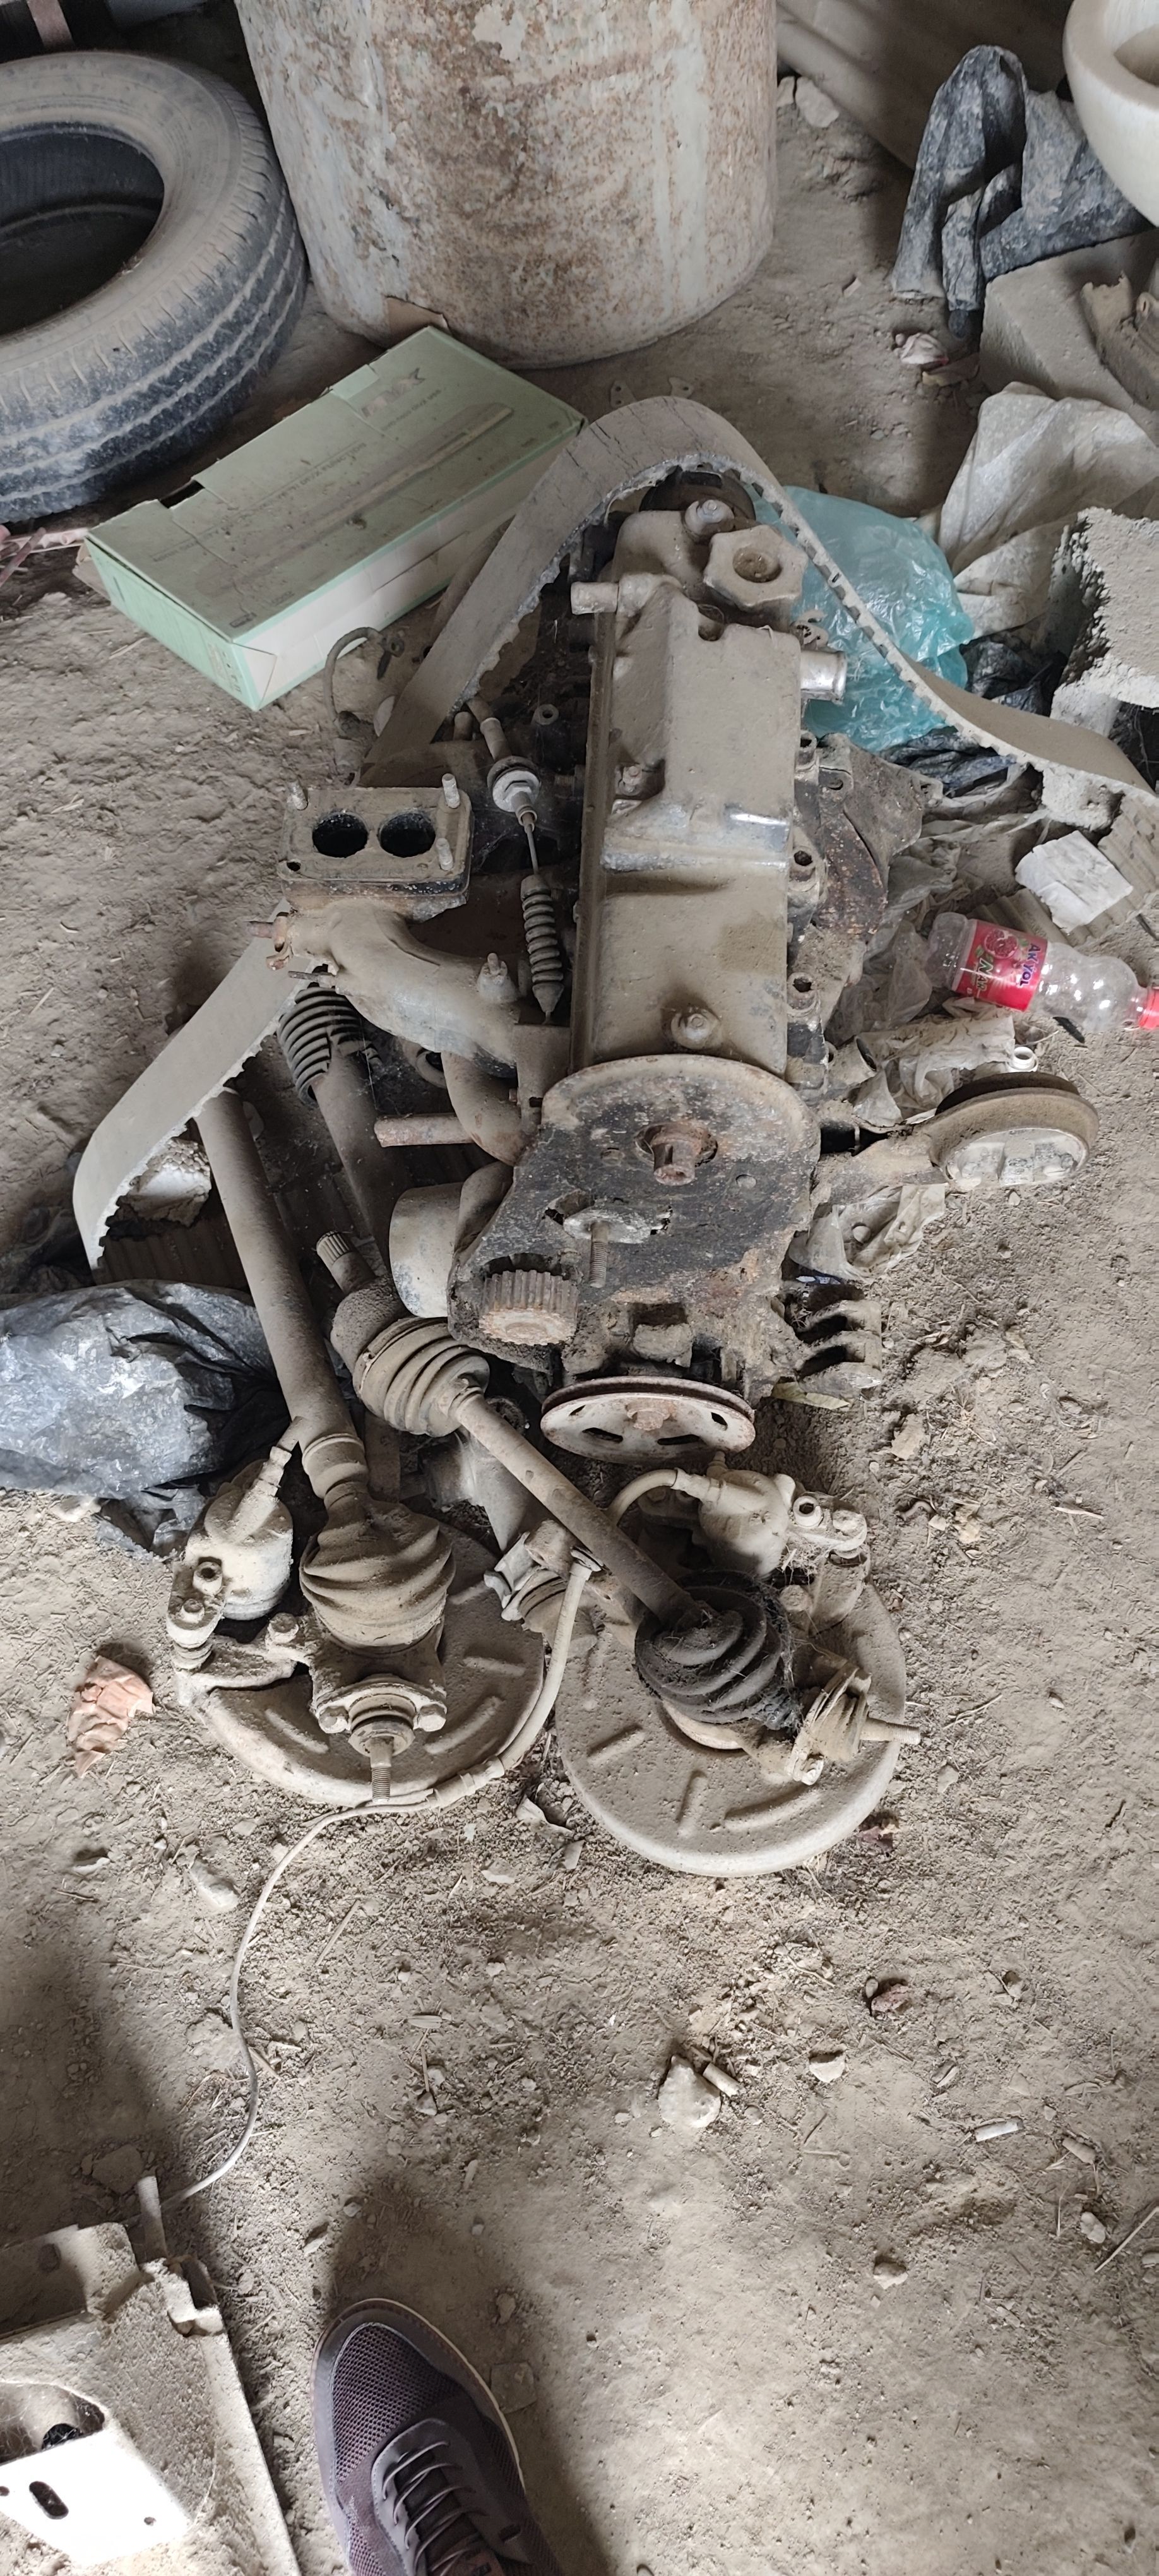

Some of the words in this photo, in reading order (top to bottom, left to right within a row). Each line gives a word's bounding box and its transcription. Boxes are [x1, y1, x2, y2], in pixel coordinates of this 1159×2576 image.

[1028, 943, 1041, 963] AK
[977, 958, 993, 991] NAR
[1019, 963, 1035, 986] YOL
